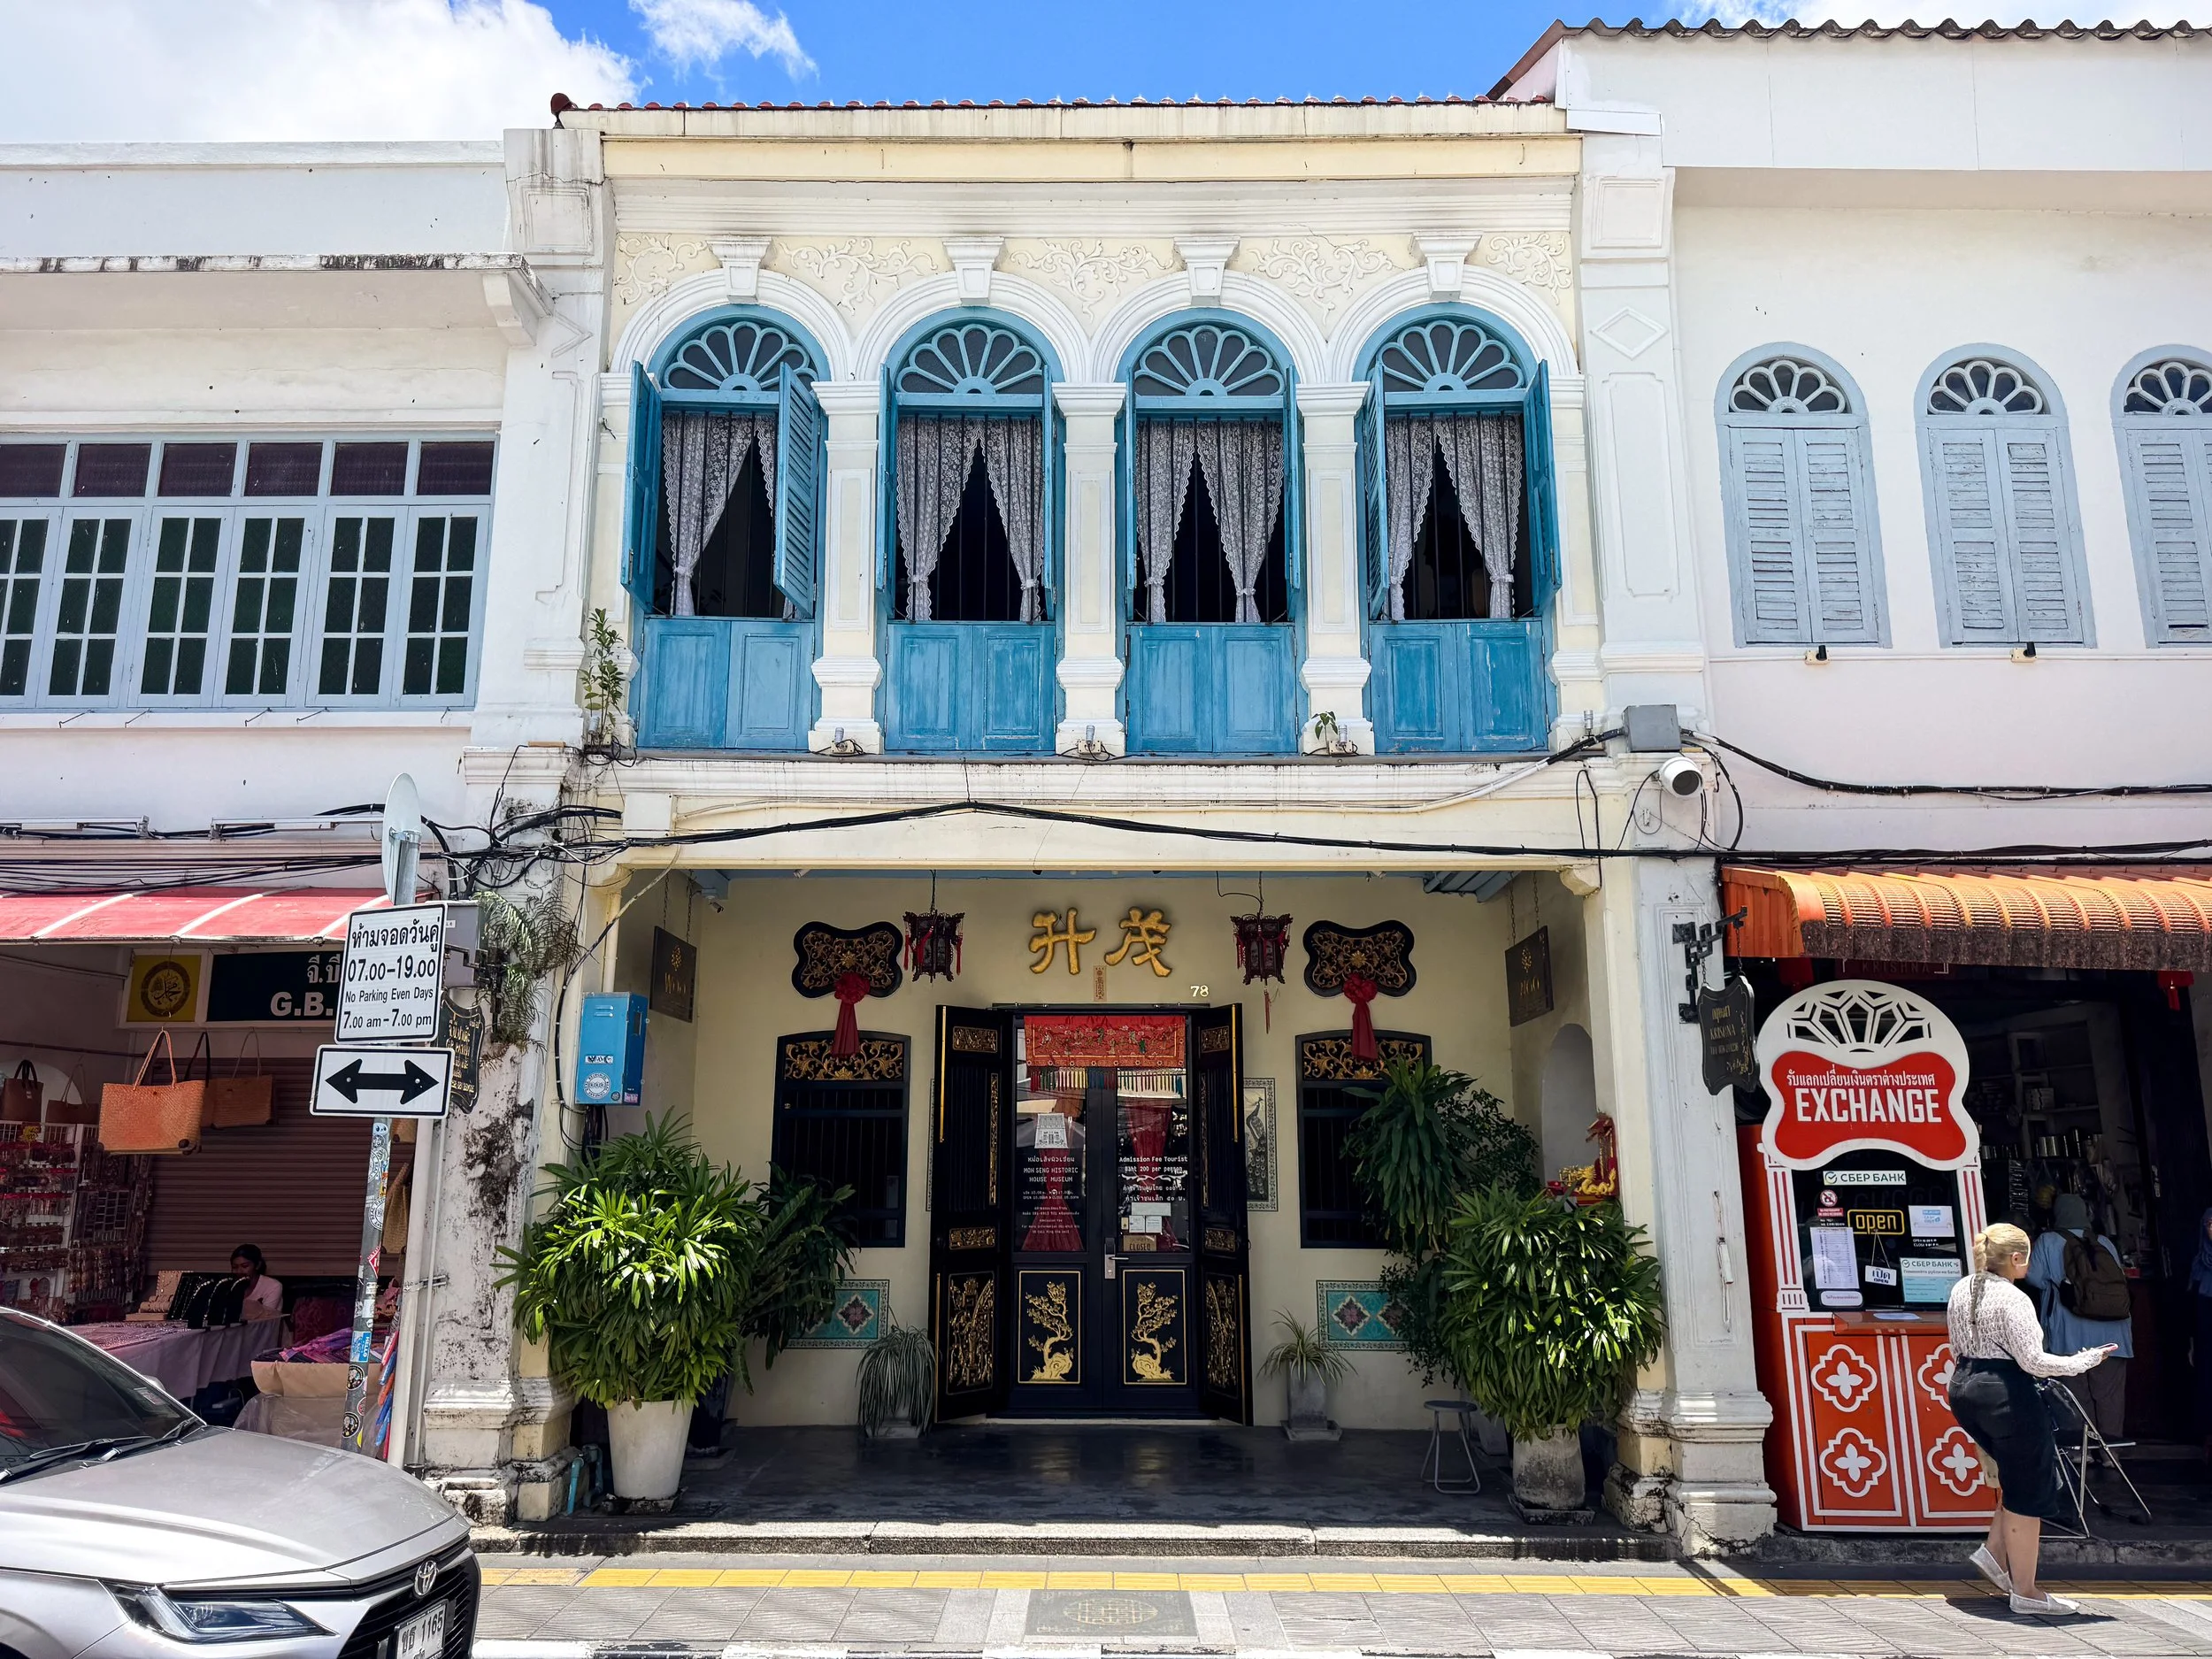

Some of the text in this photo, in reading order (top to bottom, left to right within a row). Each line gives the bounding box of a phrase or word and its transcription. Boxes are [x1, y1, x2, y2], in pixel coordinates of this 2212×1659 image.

[351, 917, 440, 953] ห้ามจอดวันคู่
[1862, 961, 1929, 973] KRISHNA
[346, 987, 434, 1003] No Parking Even Days
[1190, 985, 1210, 997] 78
[343, 1011, 364, 1029] 7.00
[366, 1018, 381, 1028] am
[391, 1009, 412, 1027] 7.00
[416, 1014, 433, 1028] pm
[1786, 1064, 1935, 1087] รับแลกเปลี่ยนเงินตราต่างประเทศ
[1795, 1088, 1942, 1123] EXCHANGE
[1840, 1172, 1905, 1182] СБЕР БАНК
[1855, 1214, 1897, 1234] open
[1871, 1267, 1891, 1280] เปิด
[421, 1610, 443, 1643] 1165
